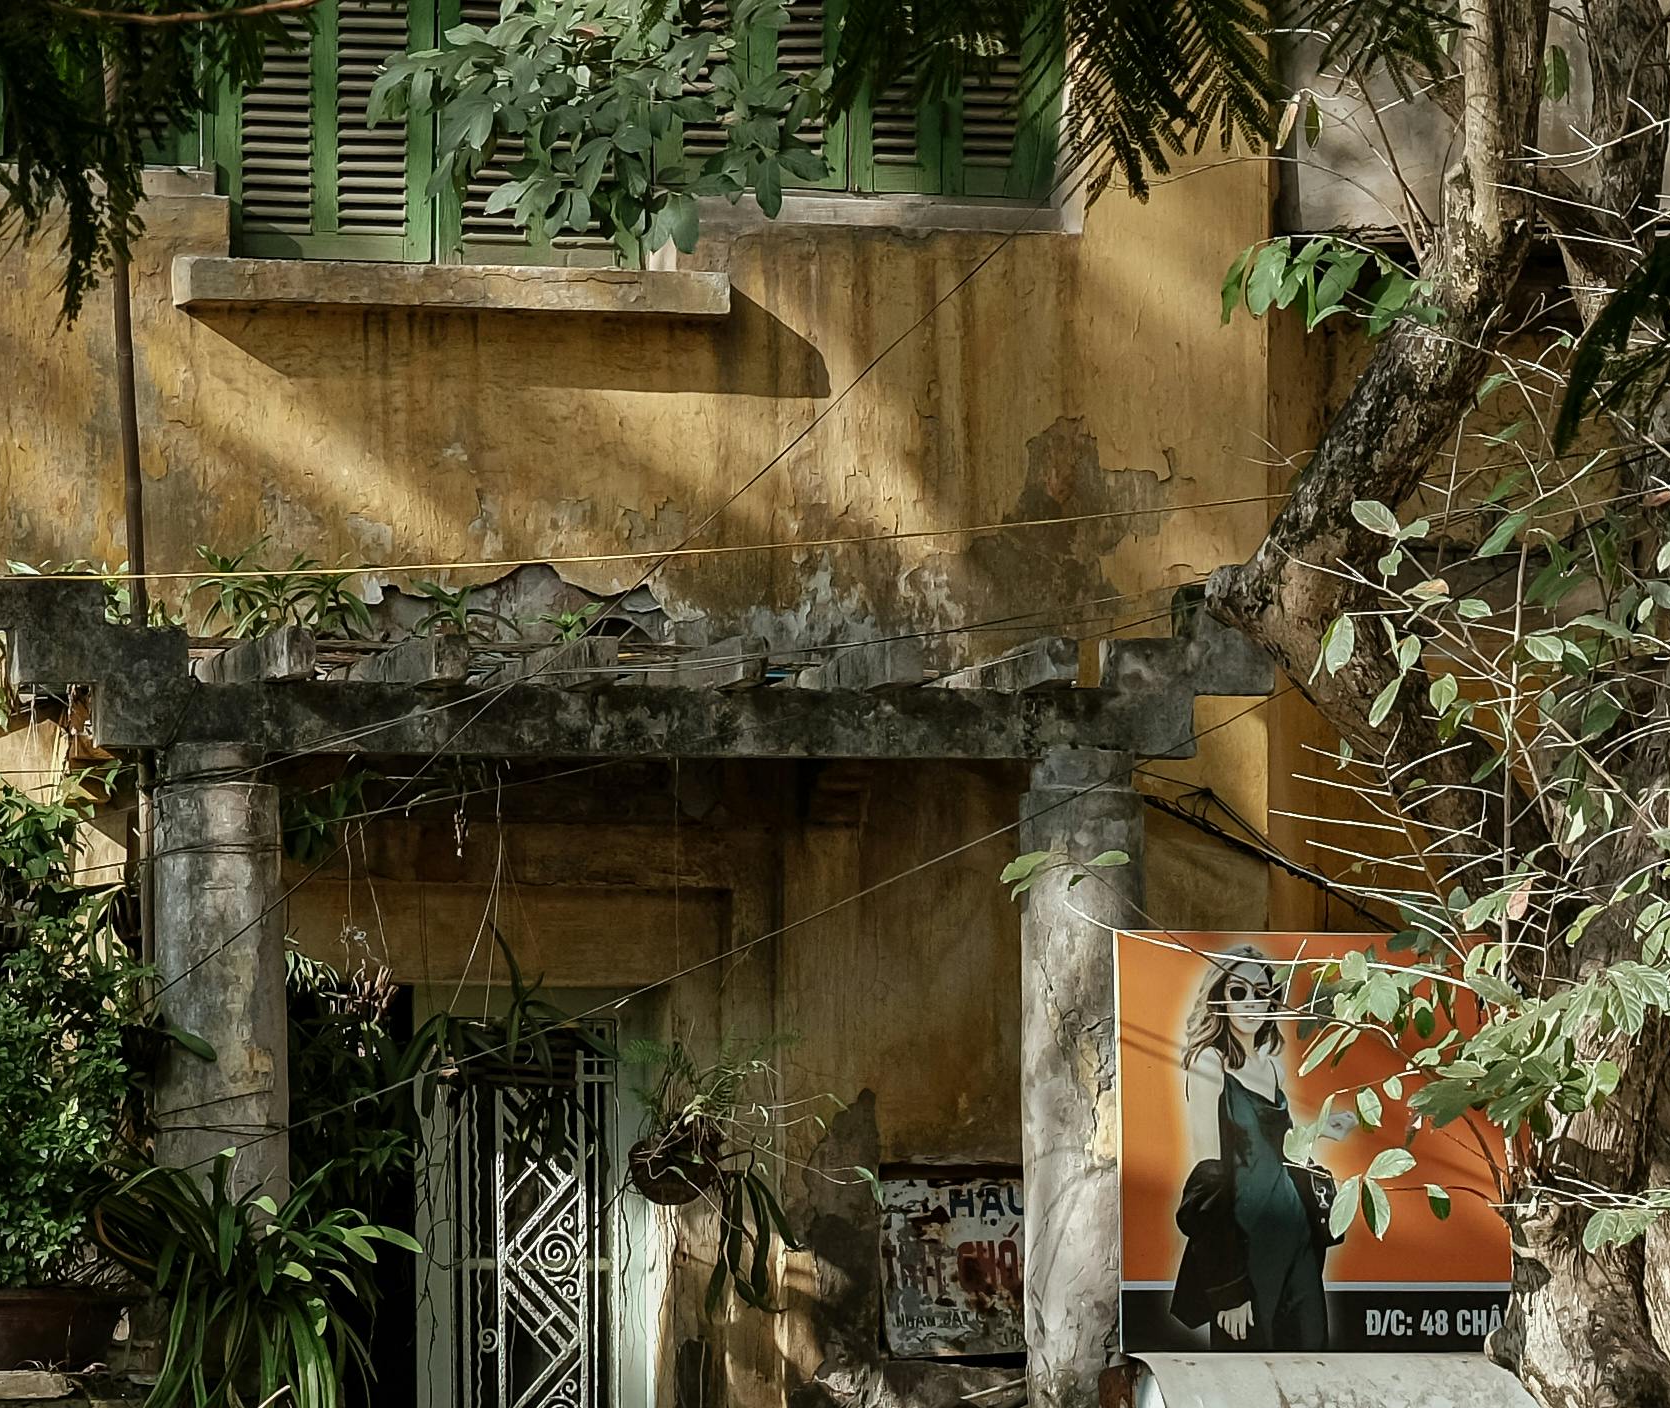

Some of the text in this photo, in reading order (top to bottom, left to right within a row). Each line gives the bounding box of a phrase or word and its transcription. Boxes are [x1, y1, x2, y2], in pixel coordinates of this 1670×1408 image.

[1365, 1305, 1510, 1337] Đ/C: 48 CHÂ
